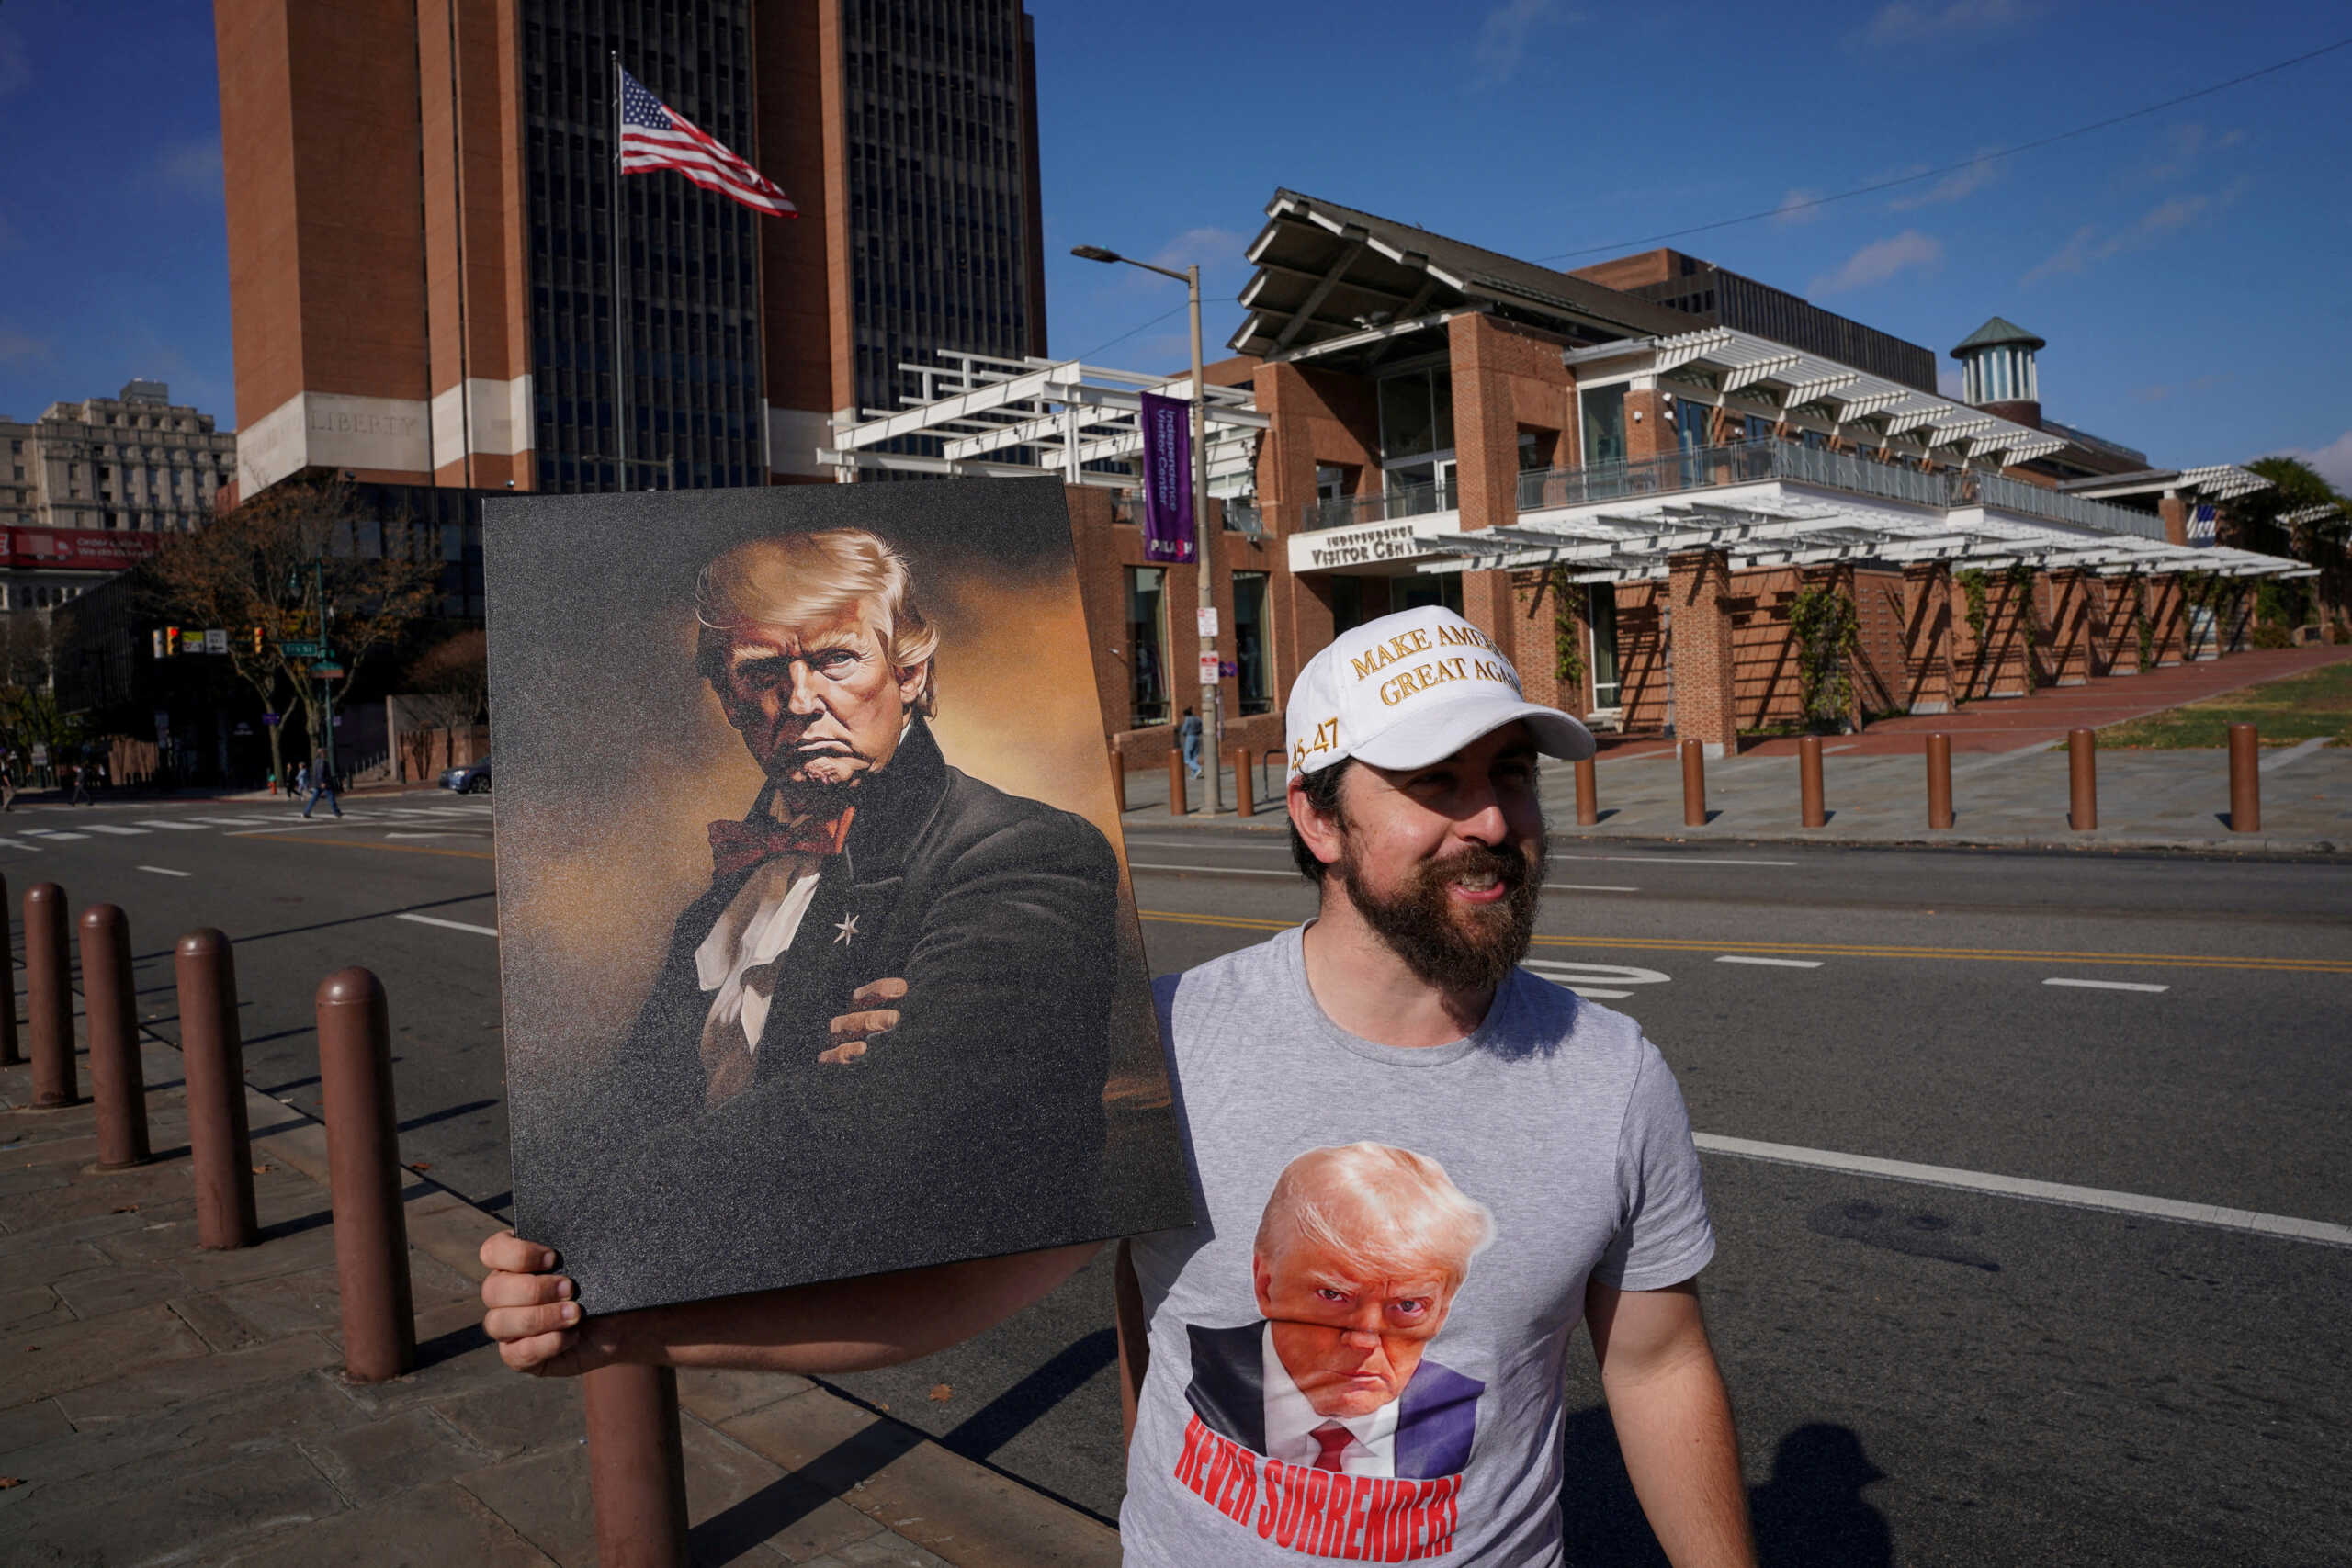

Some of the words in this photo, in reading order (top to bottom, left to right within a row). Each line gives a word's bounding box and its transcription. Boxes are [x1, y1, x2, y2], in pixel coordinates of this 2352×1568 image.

[310, 410, 417, 436] LIBERTY
[1157, 408, 1166, 455] Visitor
[1158, 457, 1168, 506] Center
[1166, 410, 1177, 512] Independence
[1312, 545, 1370, 567] VISITOR
[1373, 539, 1434, 560] CENT
[1351, 628, 1432, 682] MAKE
[1380, 658, 1469, 706] GREAT
[1291, 716, 1338, 772] 45-47
[1174, 1412, 1257, 1528] NEVER
[1257, 1460, 1462, 1563] SURRENDER!
